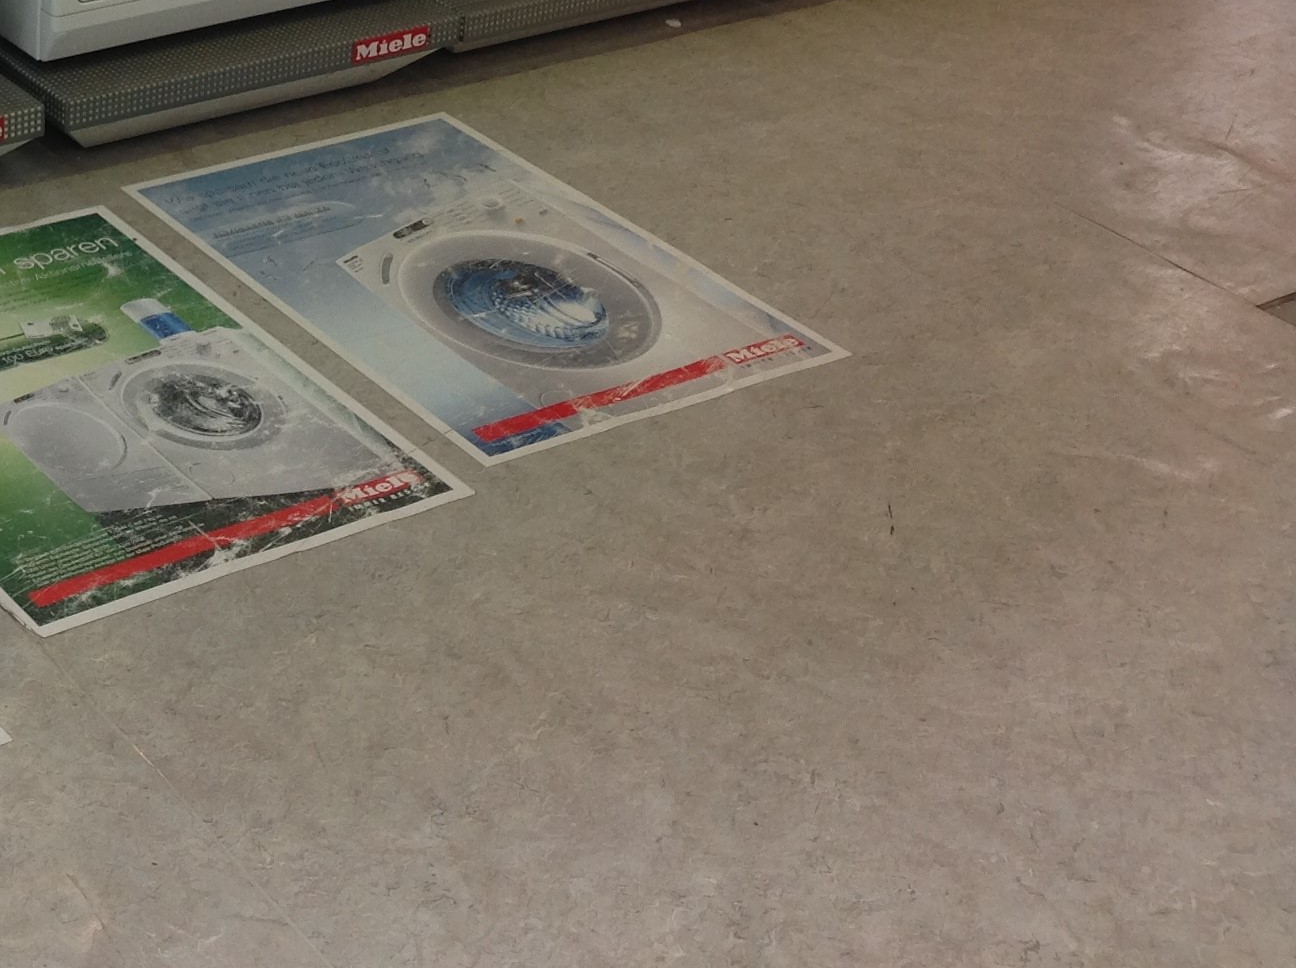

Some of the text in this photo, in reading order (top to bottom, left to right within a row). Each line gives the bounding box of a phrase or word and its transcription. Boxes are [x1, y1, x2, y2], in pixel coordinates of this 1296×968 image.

[355, 32, 427, 61] Miele
[12, 234, 119, 280] sparen
[724, 337, 799, 363] Miele
